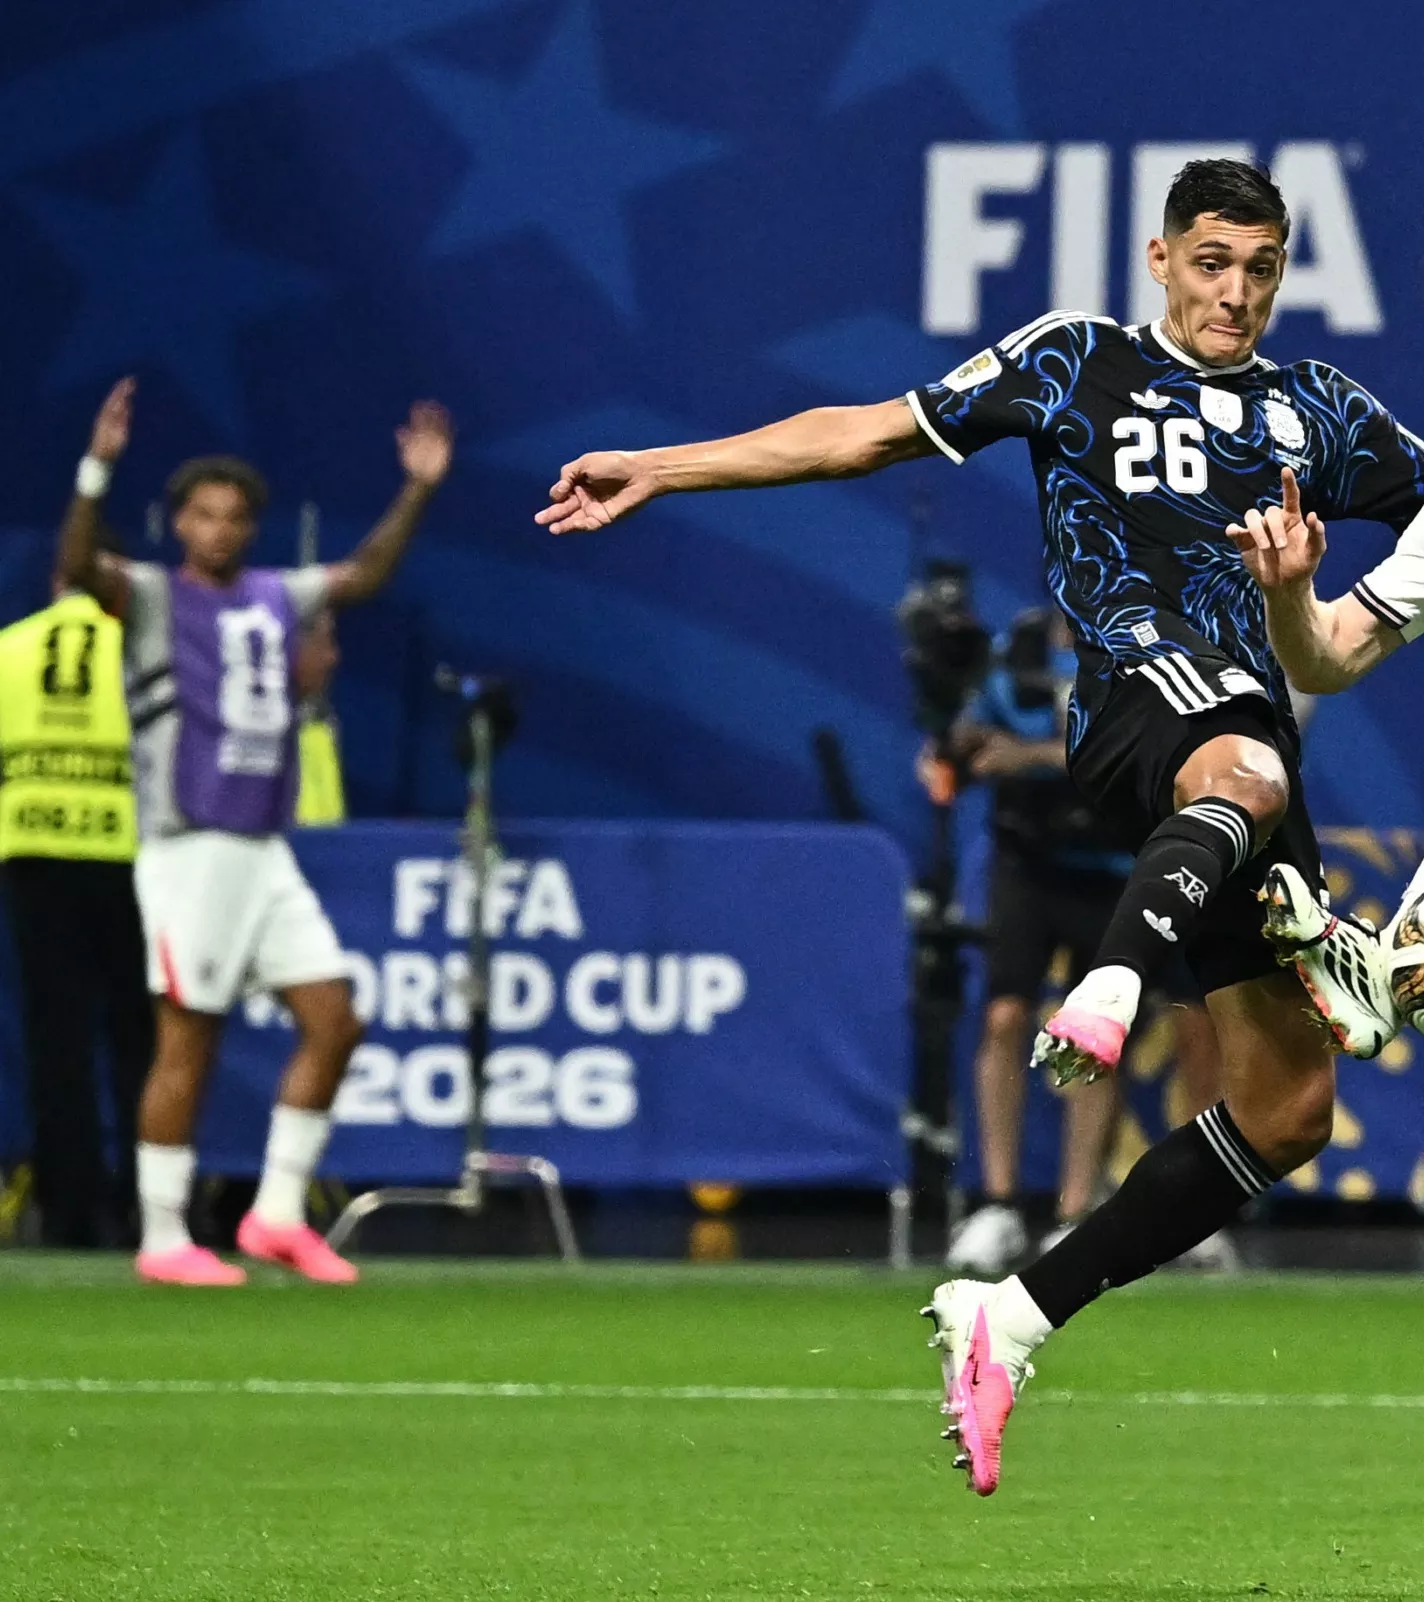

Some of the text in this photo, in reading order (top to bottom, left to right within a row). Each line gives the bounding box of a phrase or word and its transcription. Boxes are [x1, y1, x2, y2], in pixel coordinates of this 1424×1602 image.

[923, 143, 1383, 333] FIFA
[1112, 417, 1208, 494] 26
[394, 860, 583, 938] FIFA
[565, 952, 747, 1033] CUP
[333, 1044, 638, 1128] 2026
